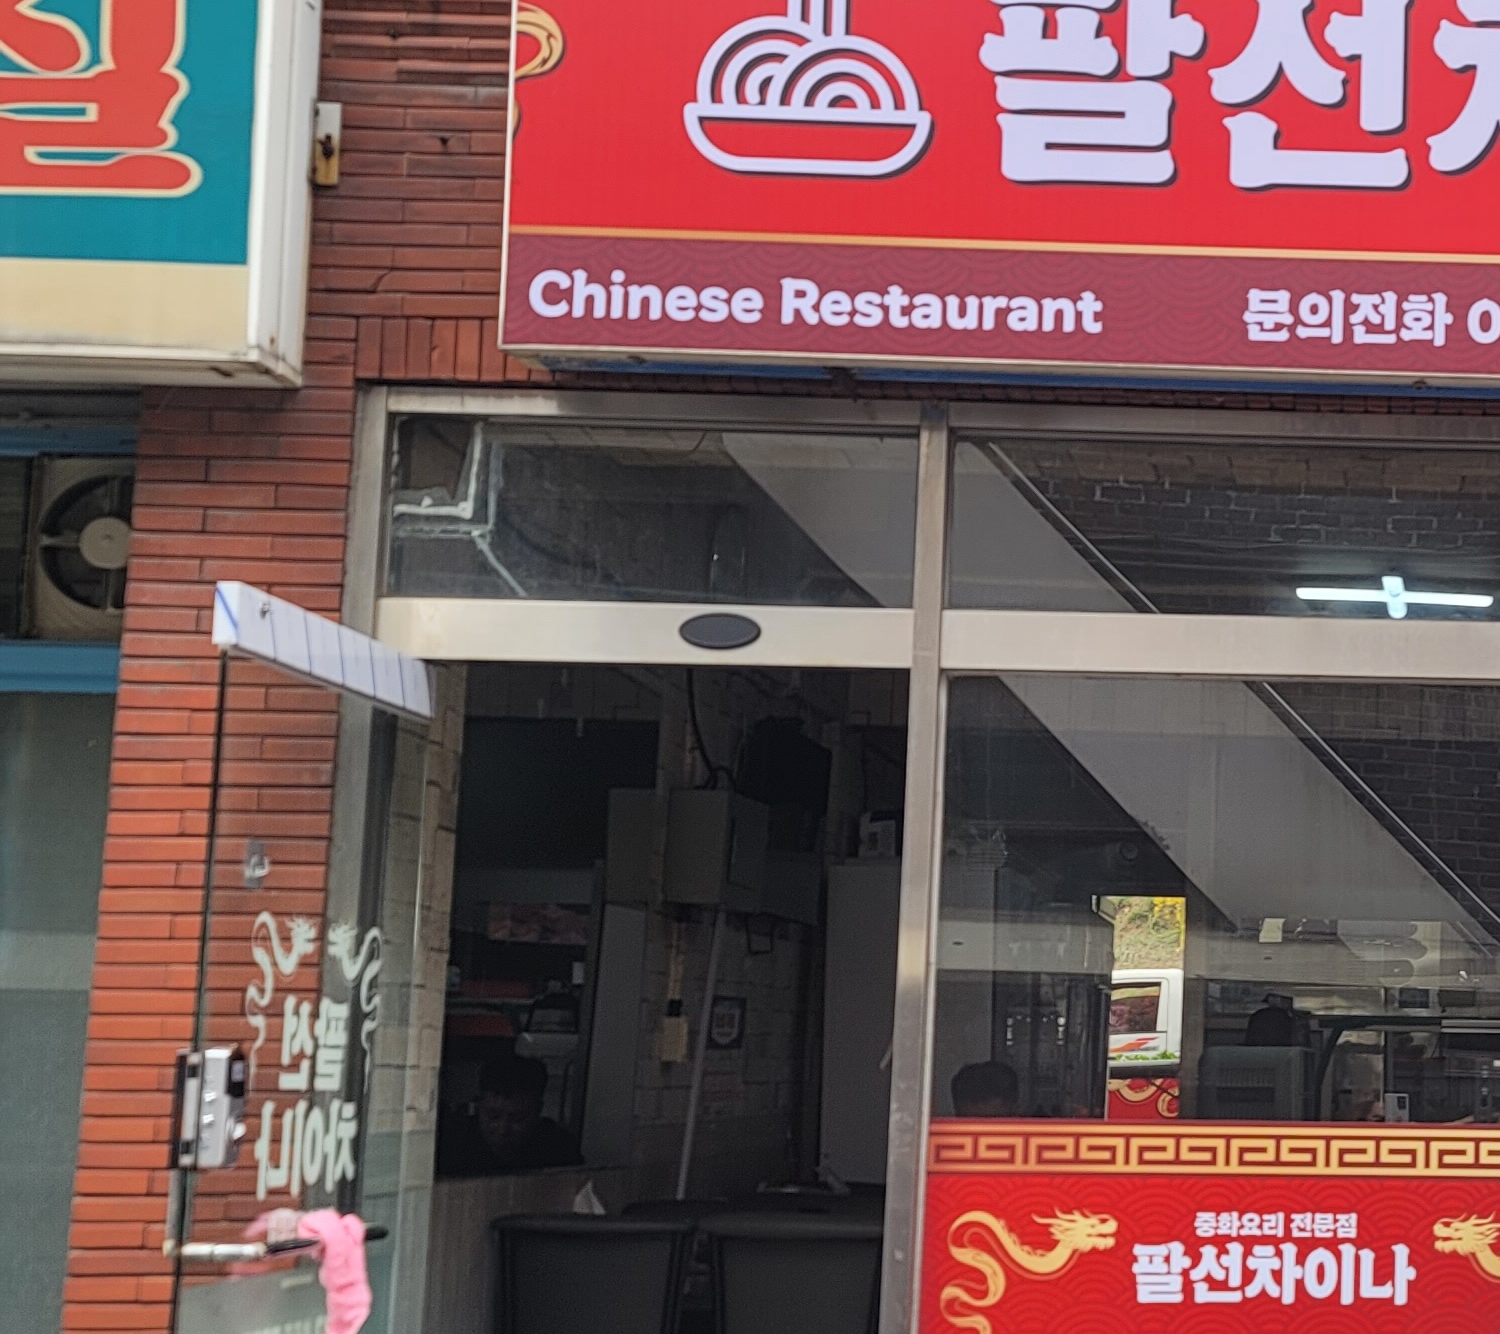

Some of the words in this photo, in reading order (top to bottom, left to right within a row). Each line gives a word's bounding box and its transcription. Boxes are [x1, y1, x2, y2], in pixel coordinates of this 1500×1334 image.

[527, 269, 764, 324] Chinese
[780, 275, 1104, 335] Restaurant
[1242, 288, 1453, 347] 문의전화
[1194, 1210, 1286, 1238] 중화요리
[1290, 1212, 1359, 1239] 전문점
[1131, 1240, 1418, 1306] 팔선차이나
